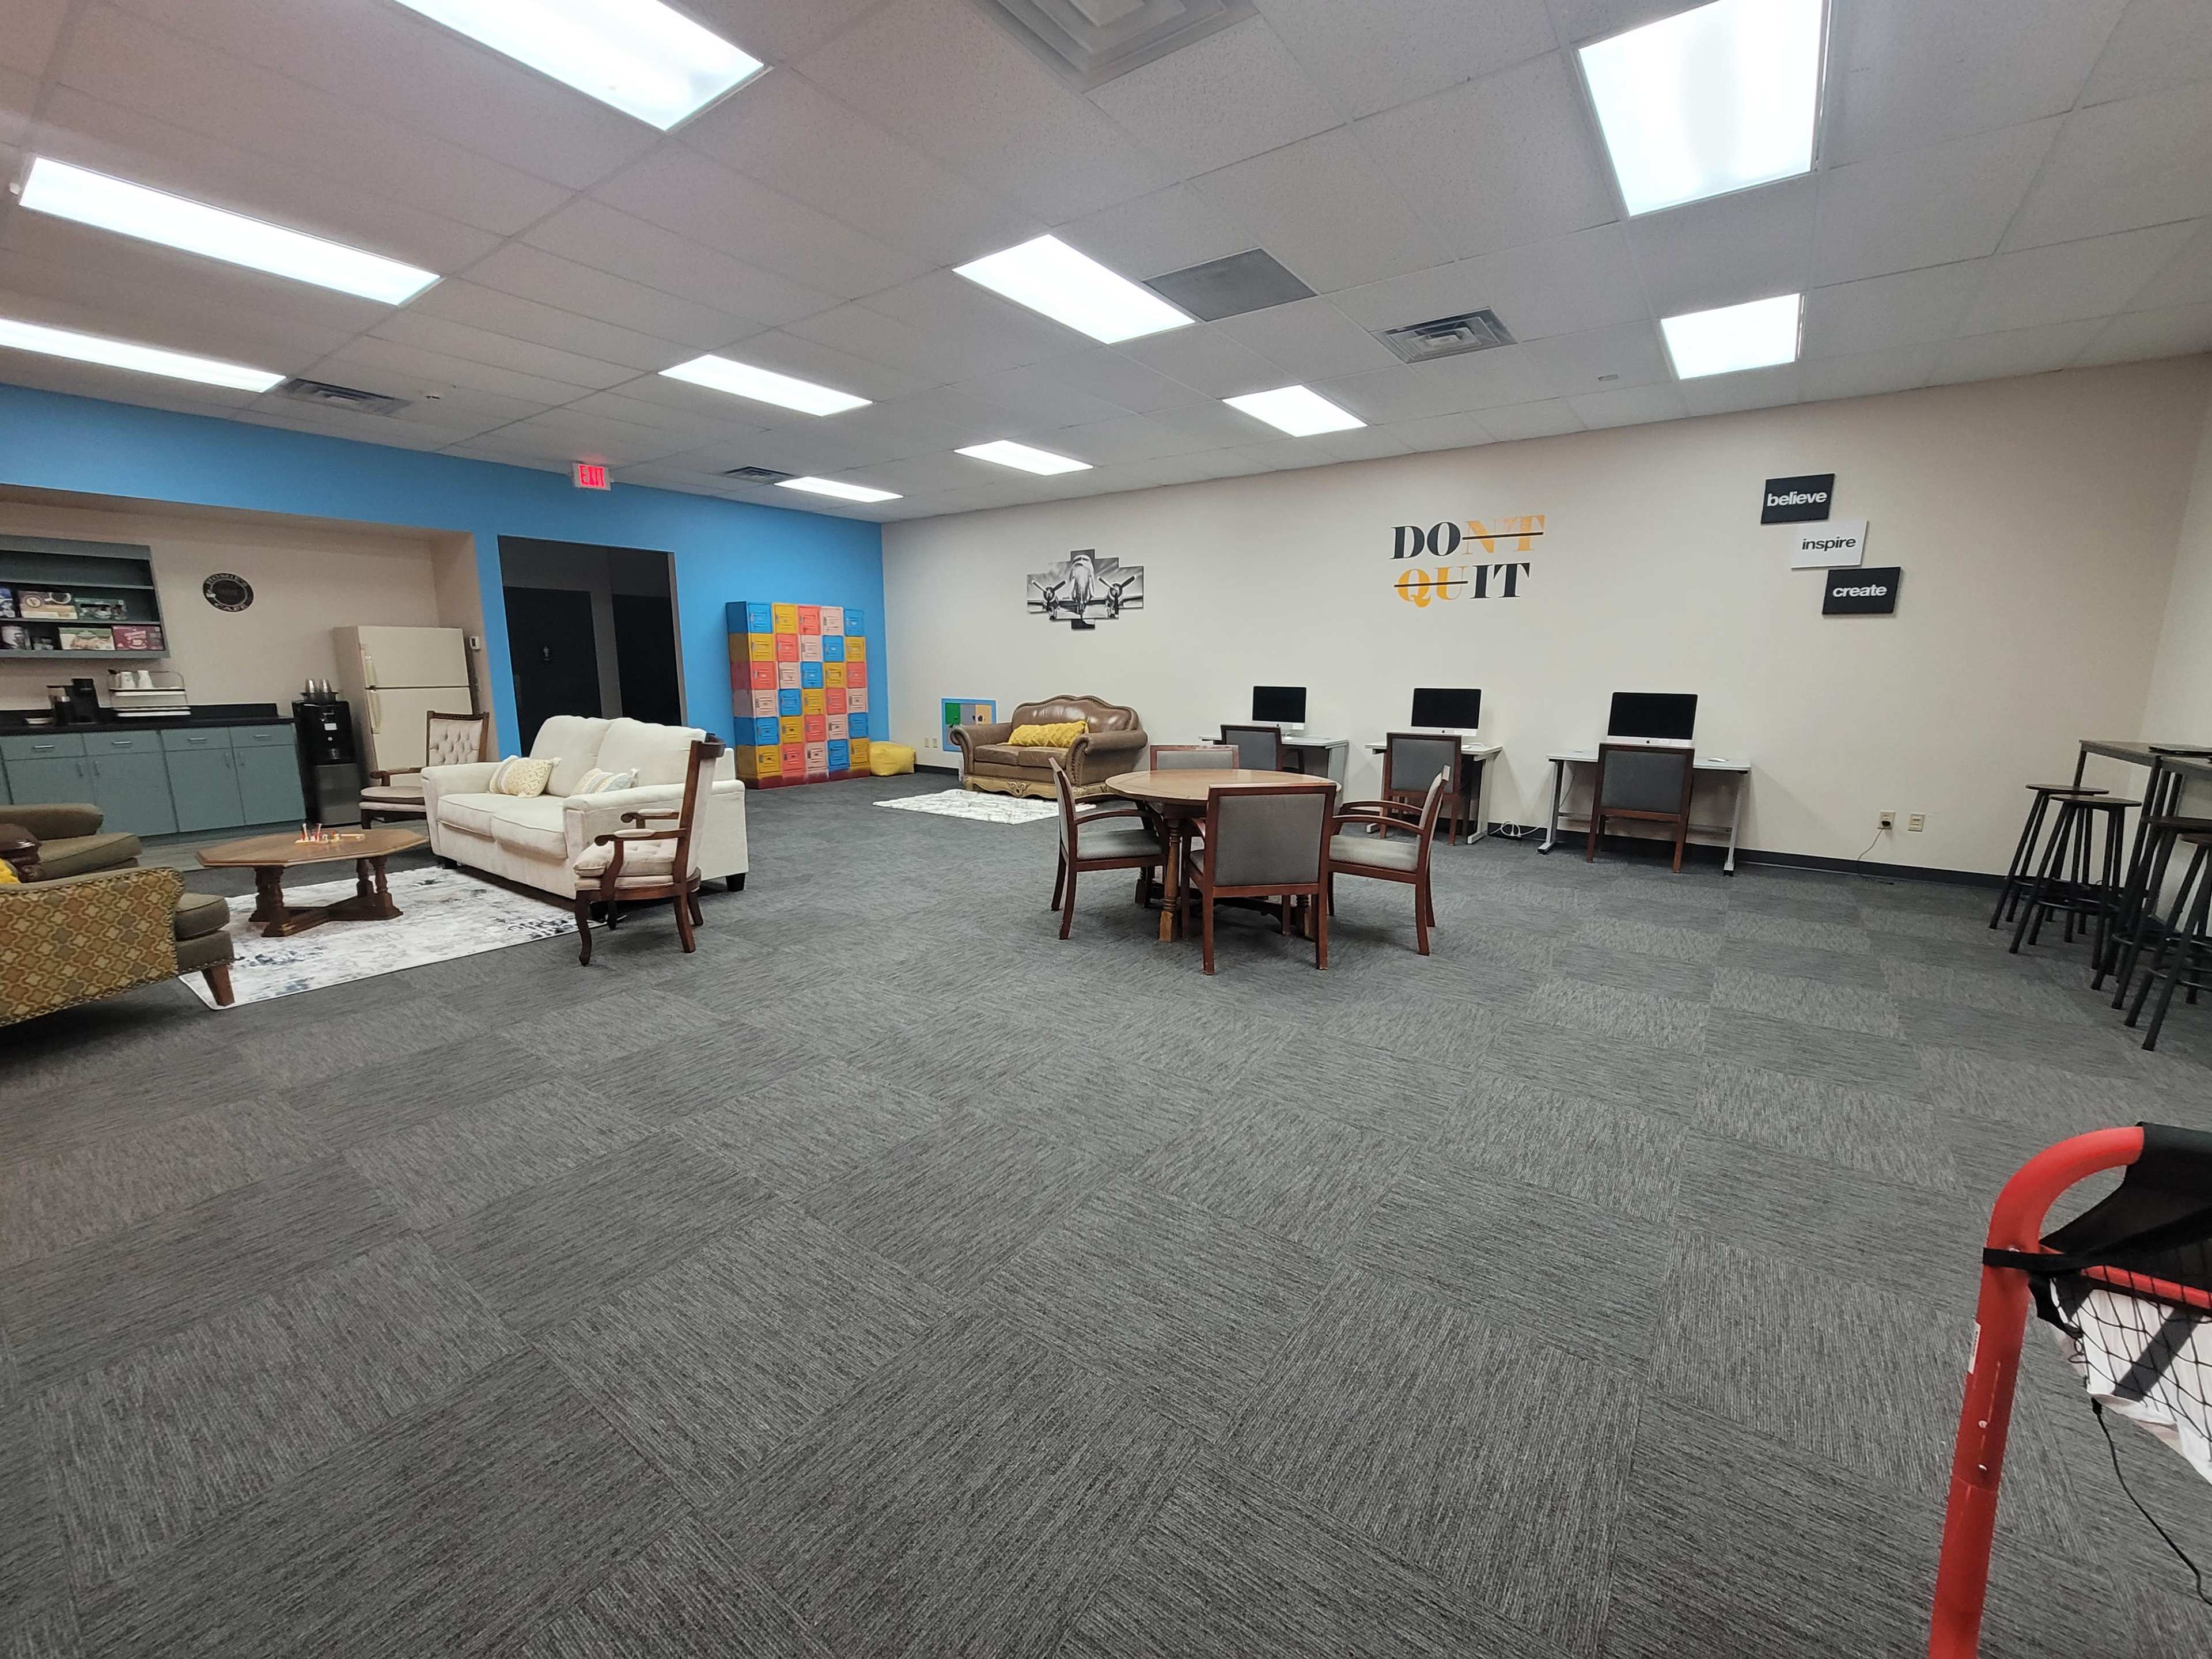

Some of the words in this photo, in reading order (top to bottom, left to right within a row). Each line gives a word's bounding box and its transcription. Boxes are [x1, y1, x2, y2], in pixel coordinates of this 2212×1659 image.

[578, 465, 604, 488] EXIT
[1767, 491, 1827, 507] believe
[1802, 536, 1856, 551] inspire
[1394, 562, 1531, 608] QUIT
[1832, 584, 1887, 597] create
